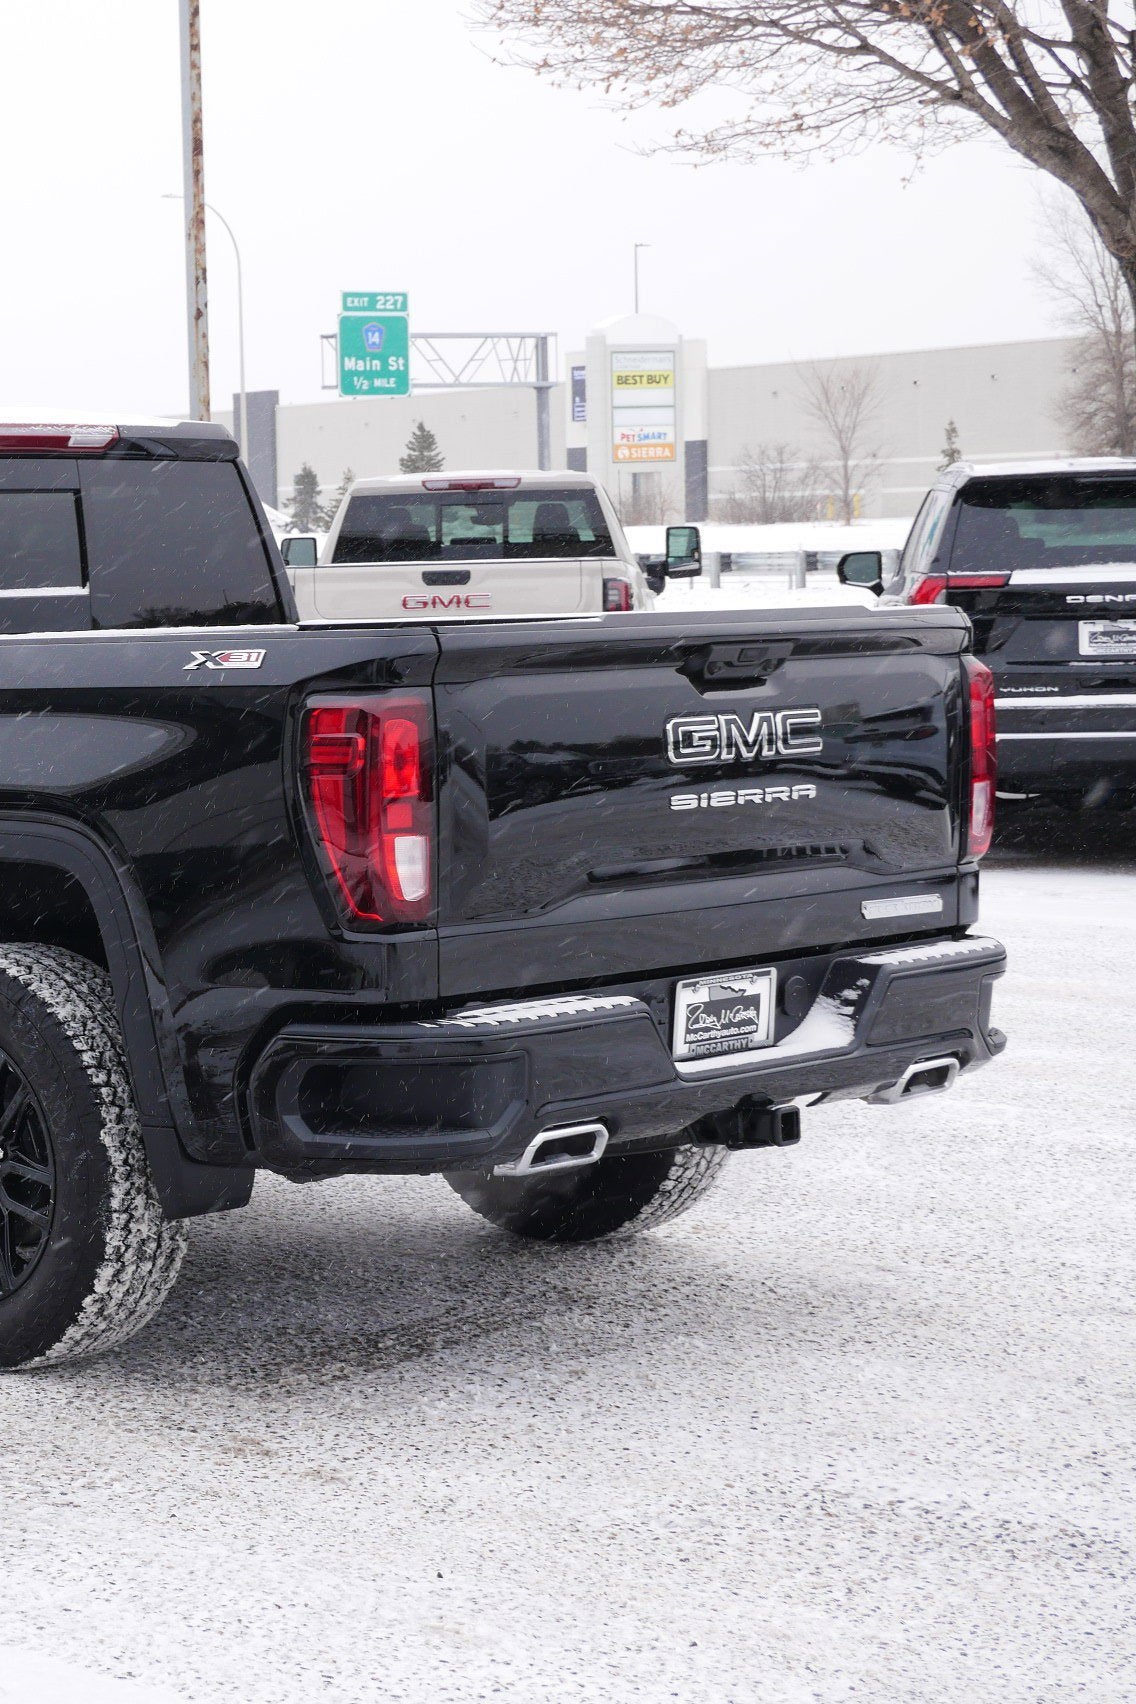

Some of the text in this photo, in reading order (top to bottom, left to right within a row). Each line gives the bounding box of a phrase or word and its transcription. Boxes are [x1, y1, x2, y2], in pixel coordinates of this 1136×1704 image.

[346, 295, 404, 310] EXIT 227
[367, 331, 380, 345] 14
[344, 357, 405, 371] Main St
[374, 377, 396, 388] MILE
[616, 374, 670, 385] BEST BUY
[630, 446, 671, 459] SIERRA
[401, 593, 492, 611] GMC
[182, 648, 266, 670] X31
[666, 707, 824, 764] GMC
[670, 784, 817, 811] SIERRA
[698, 973, 753, 986] MINNESOTA
[685, 1024, 757, 1042] McCarthyauto.com
[696, 1037, 748, 1056] MCCARTHY
